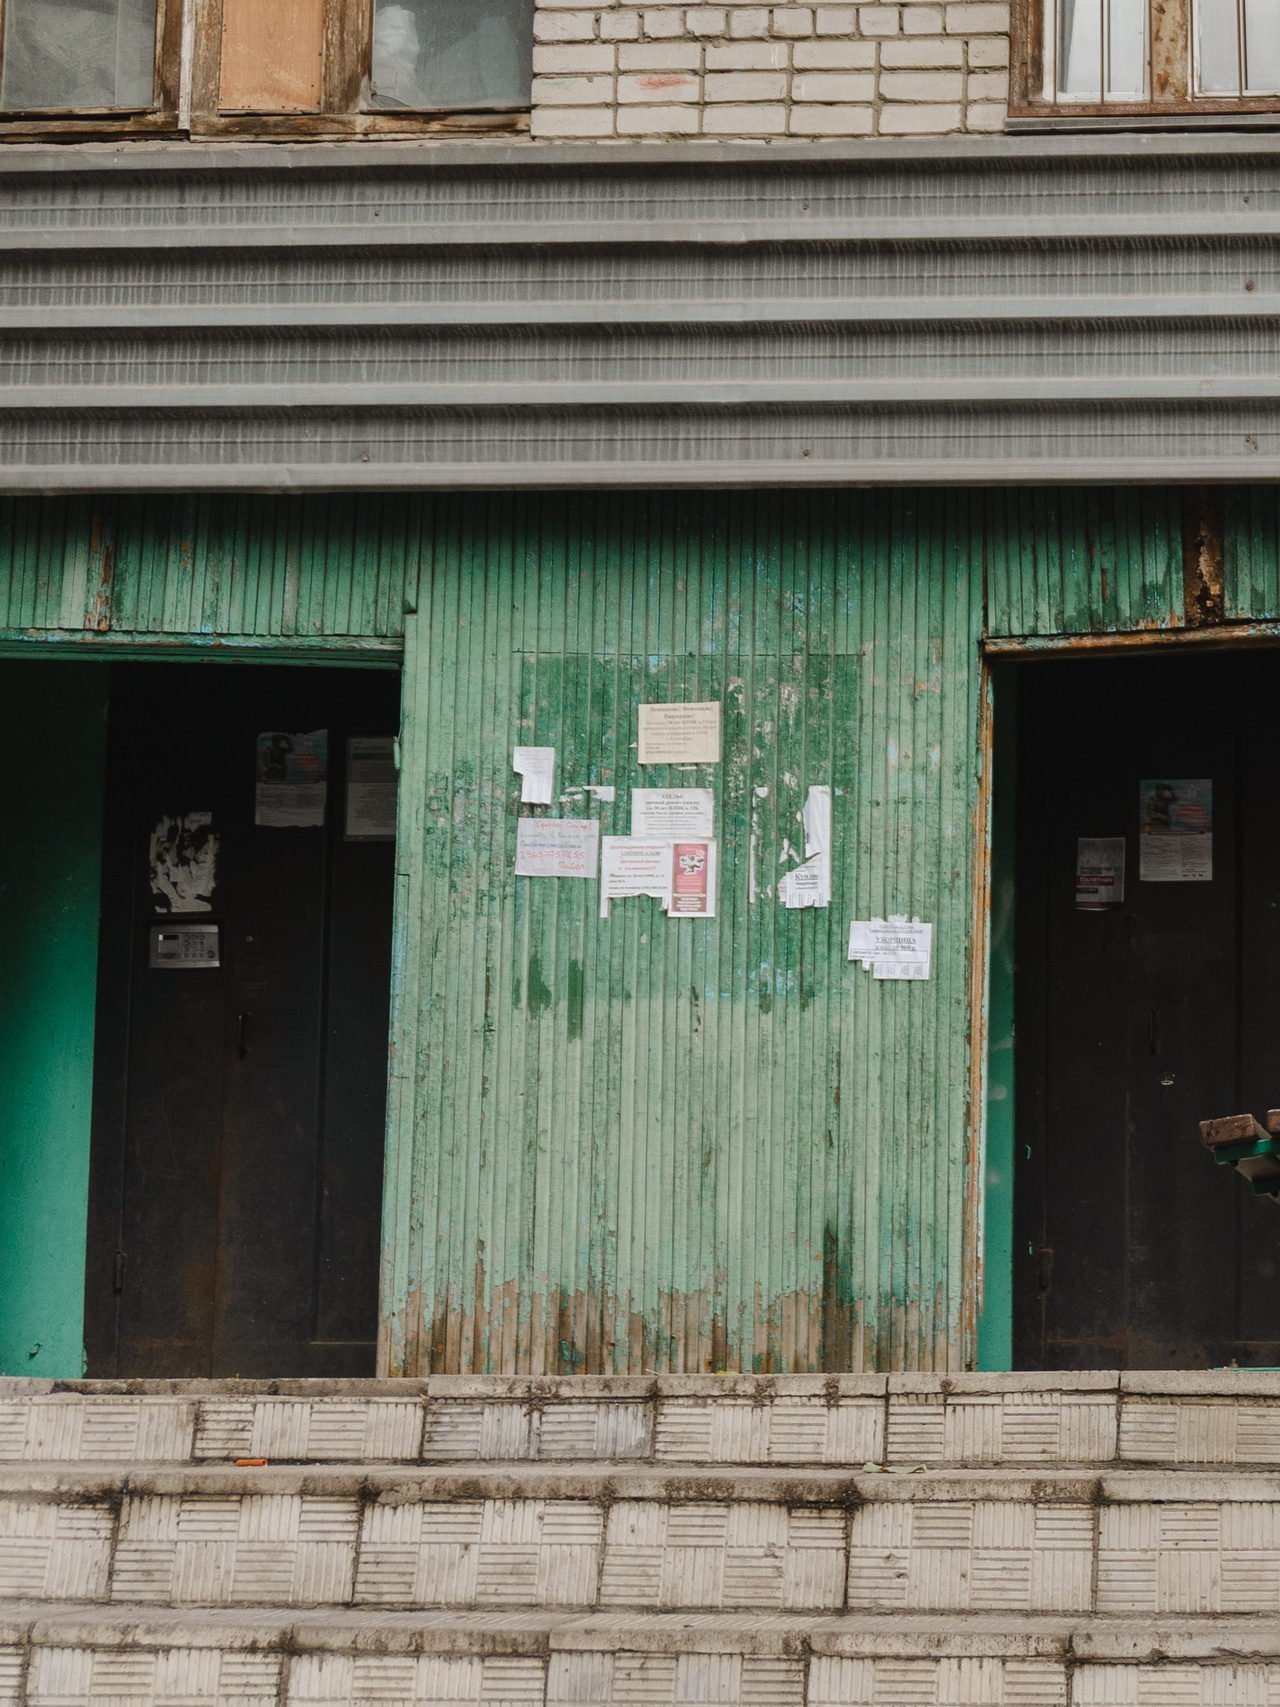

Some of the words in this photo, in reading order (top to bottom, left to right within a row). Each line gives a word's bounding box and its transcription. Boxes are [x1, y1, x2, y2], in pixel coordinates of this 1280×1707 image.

[536, 820, 562, 829] Срочно
[566, 822, 593, 832] Сниму!
[558, 861, 585, 870] Павел
